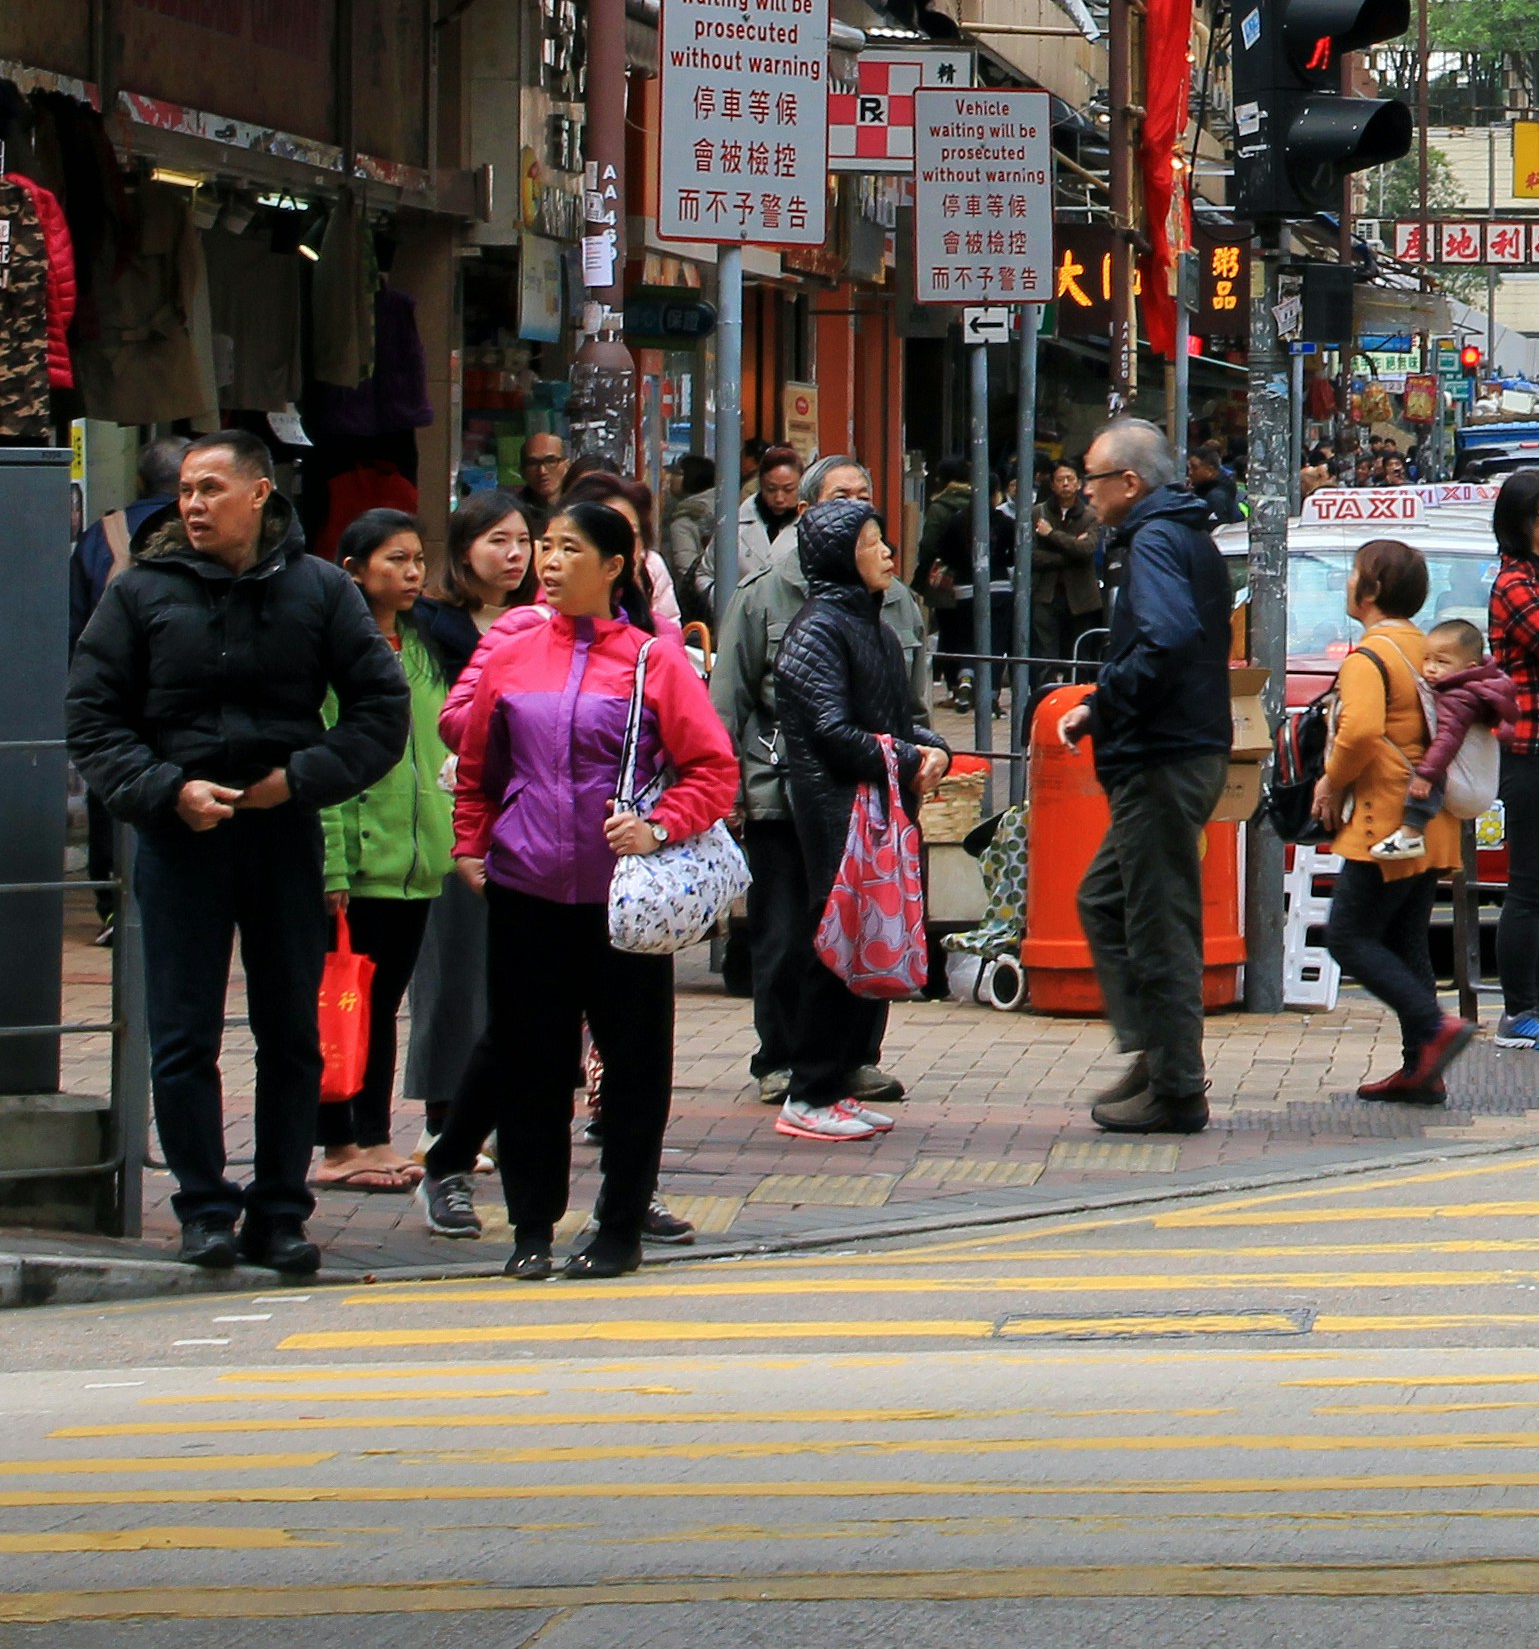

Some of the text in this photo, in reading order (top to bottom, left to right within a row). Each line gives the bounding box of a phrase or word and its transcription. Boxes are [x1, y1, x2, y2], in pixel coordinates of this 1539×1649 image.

[694, 17, 799, 46] prosecuted
[670, 47, 820, 83] without warning
[693, 85, 798, 128] 停車等候
[955, 98, 1010, 117] Vehicle
[929, 123, 1037, 140] waiting will be
[692, 138, 797, 178] 會被檢控
[941, 144, 1026, 164] prosecuted
[922, 166, 1046, 186] without warning
[677, 188, 809, 231] 而不予警告
[942, 193, 1028, 218] 停車等候
[943, 230, 1028, 256] 會被檢控
[931, 265, 1039, 293] 而不予警告
[1312, 498, 1415, 519] TAXI
